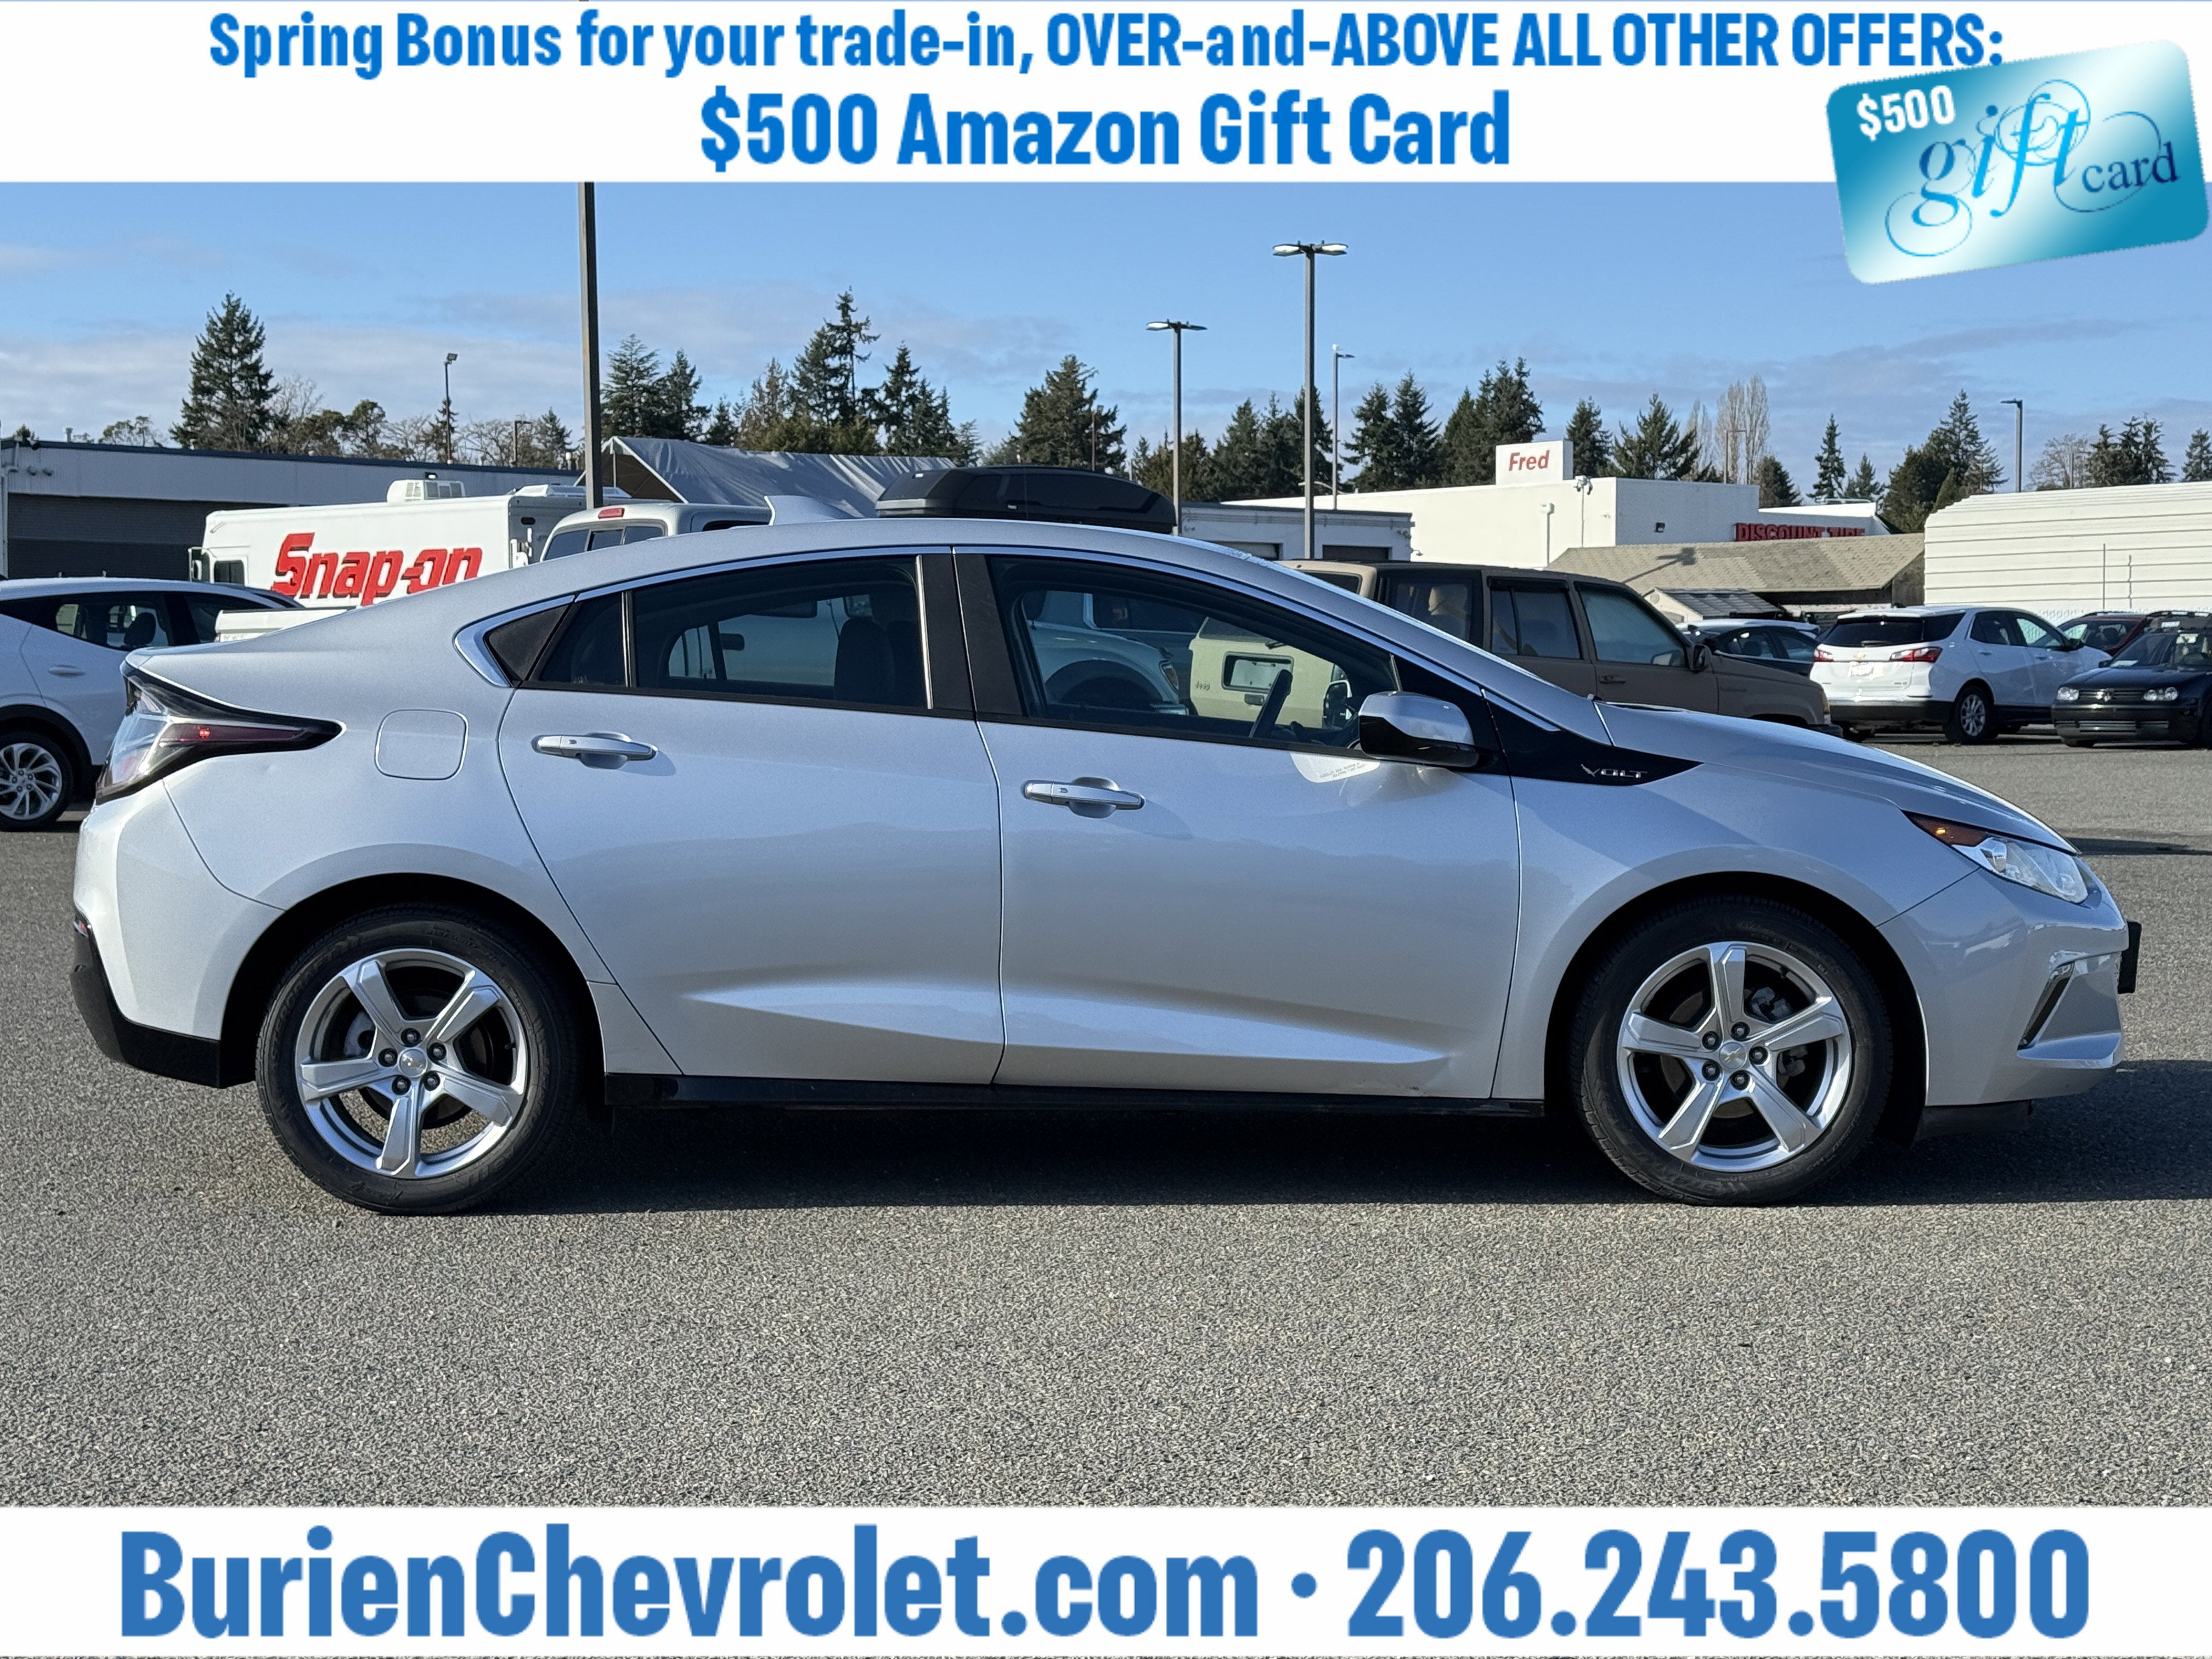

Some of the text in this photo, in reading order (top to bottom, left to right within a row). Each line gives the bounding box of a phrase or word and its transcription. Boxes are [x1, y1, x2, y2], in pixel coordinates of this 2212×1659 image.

[1509, 449, 1550, 471] Fred
[1735, 522, 1825, 542] DISCOUNT
[271, 532, 483, 607] Snap-on
[1581, 764, 1648, 778] VOLT
